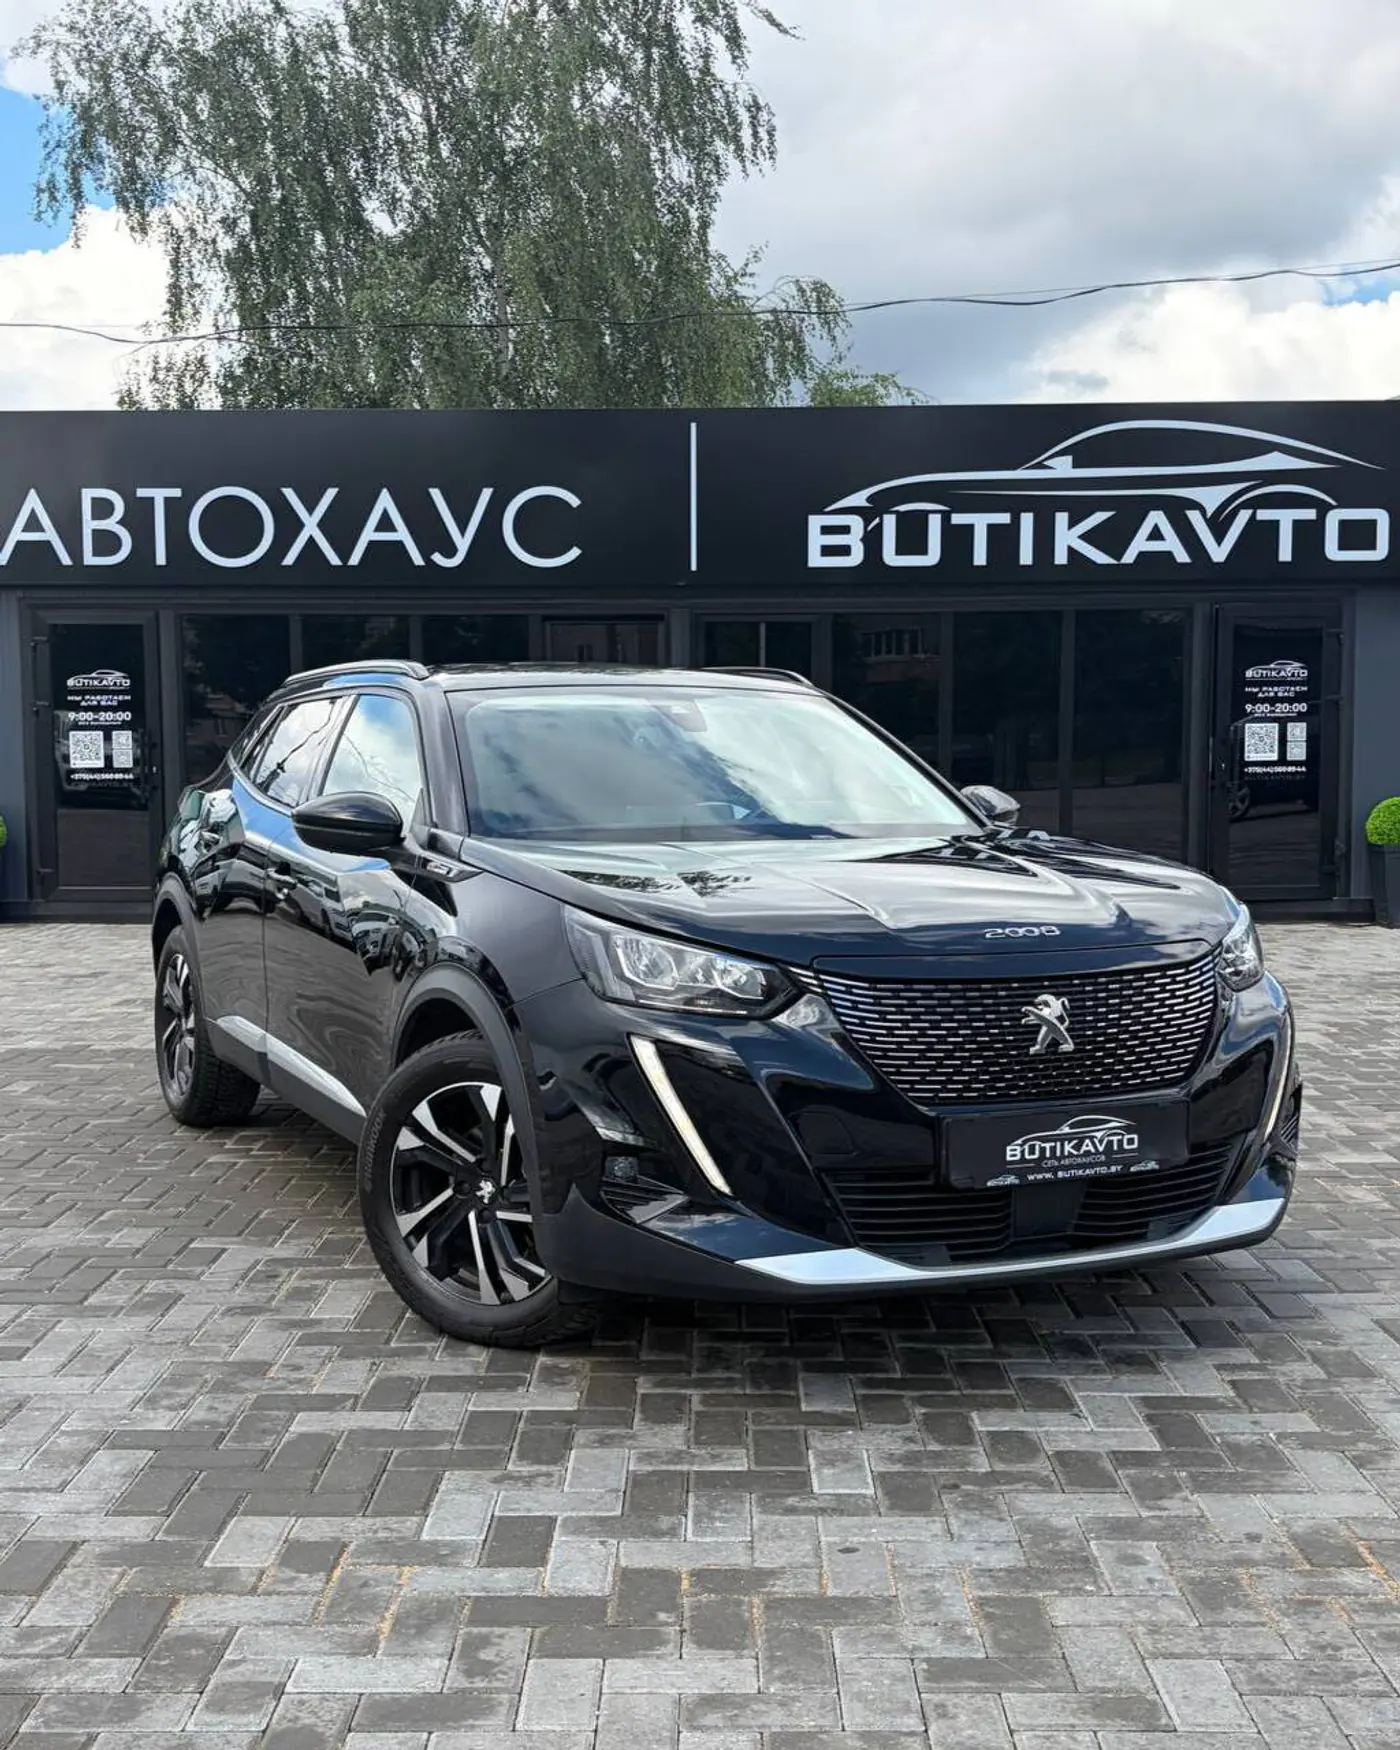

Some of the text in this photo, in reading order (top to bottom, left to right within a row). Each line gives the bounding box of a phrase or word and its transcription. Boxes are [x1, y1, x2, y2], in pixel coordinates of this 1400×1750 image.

[0, 486, 583, 568] АВТОХАУС
[807, 507, 1390, 567] BUTIKAVTO
[1245, 668, 1308, 678] BUTIKAVTO
[67, 679, 131, 687] BUTIKAVTO
[1245, 702, 1308, 713] 9:00-20:00
[68, 711, 132, 721] 9:00-20:00
[984, 925, 1061, 939] 2008
[1006, 1133, 1139, 1161] BUTIKAVTO
